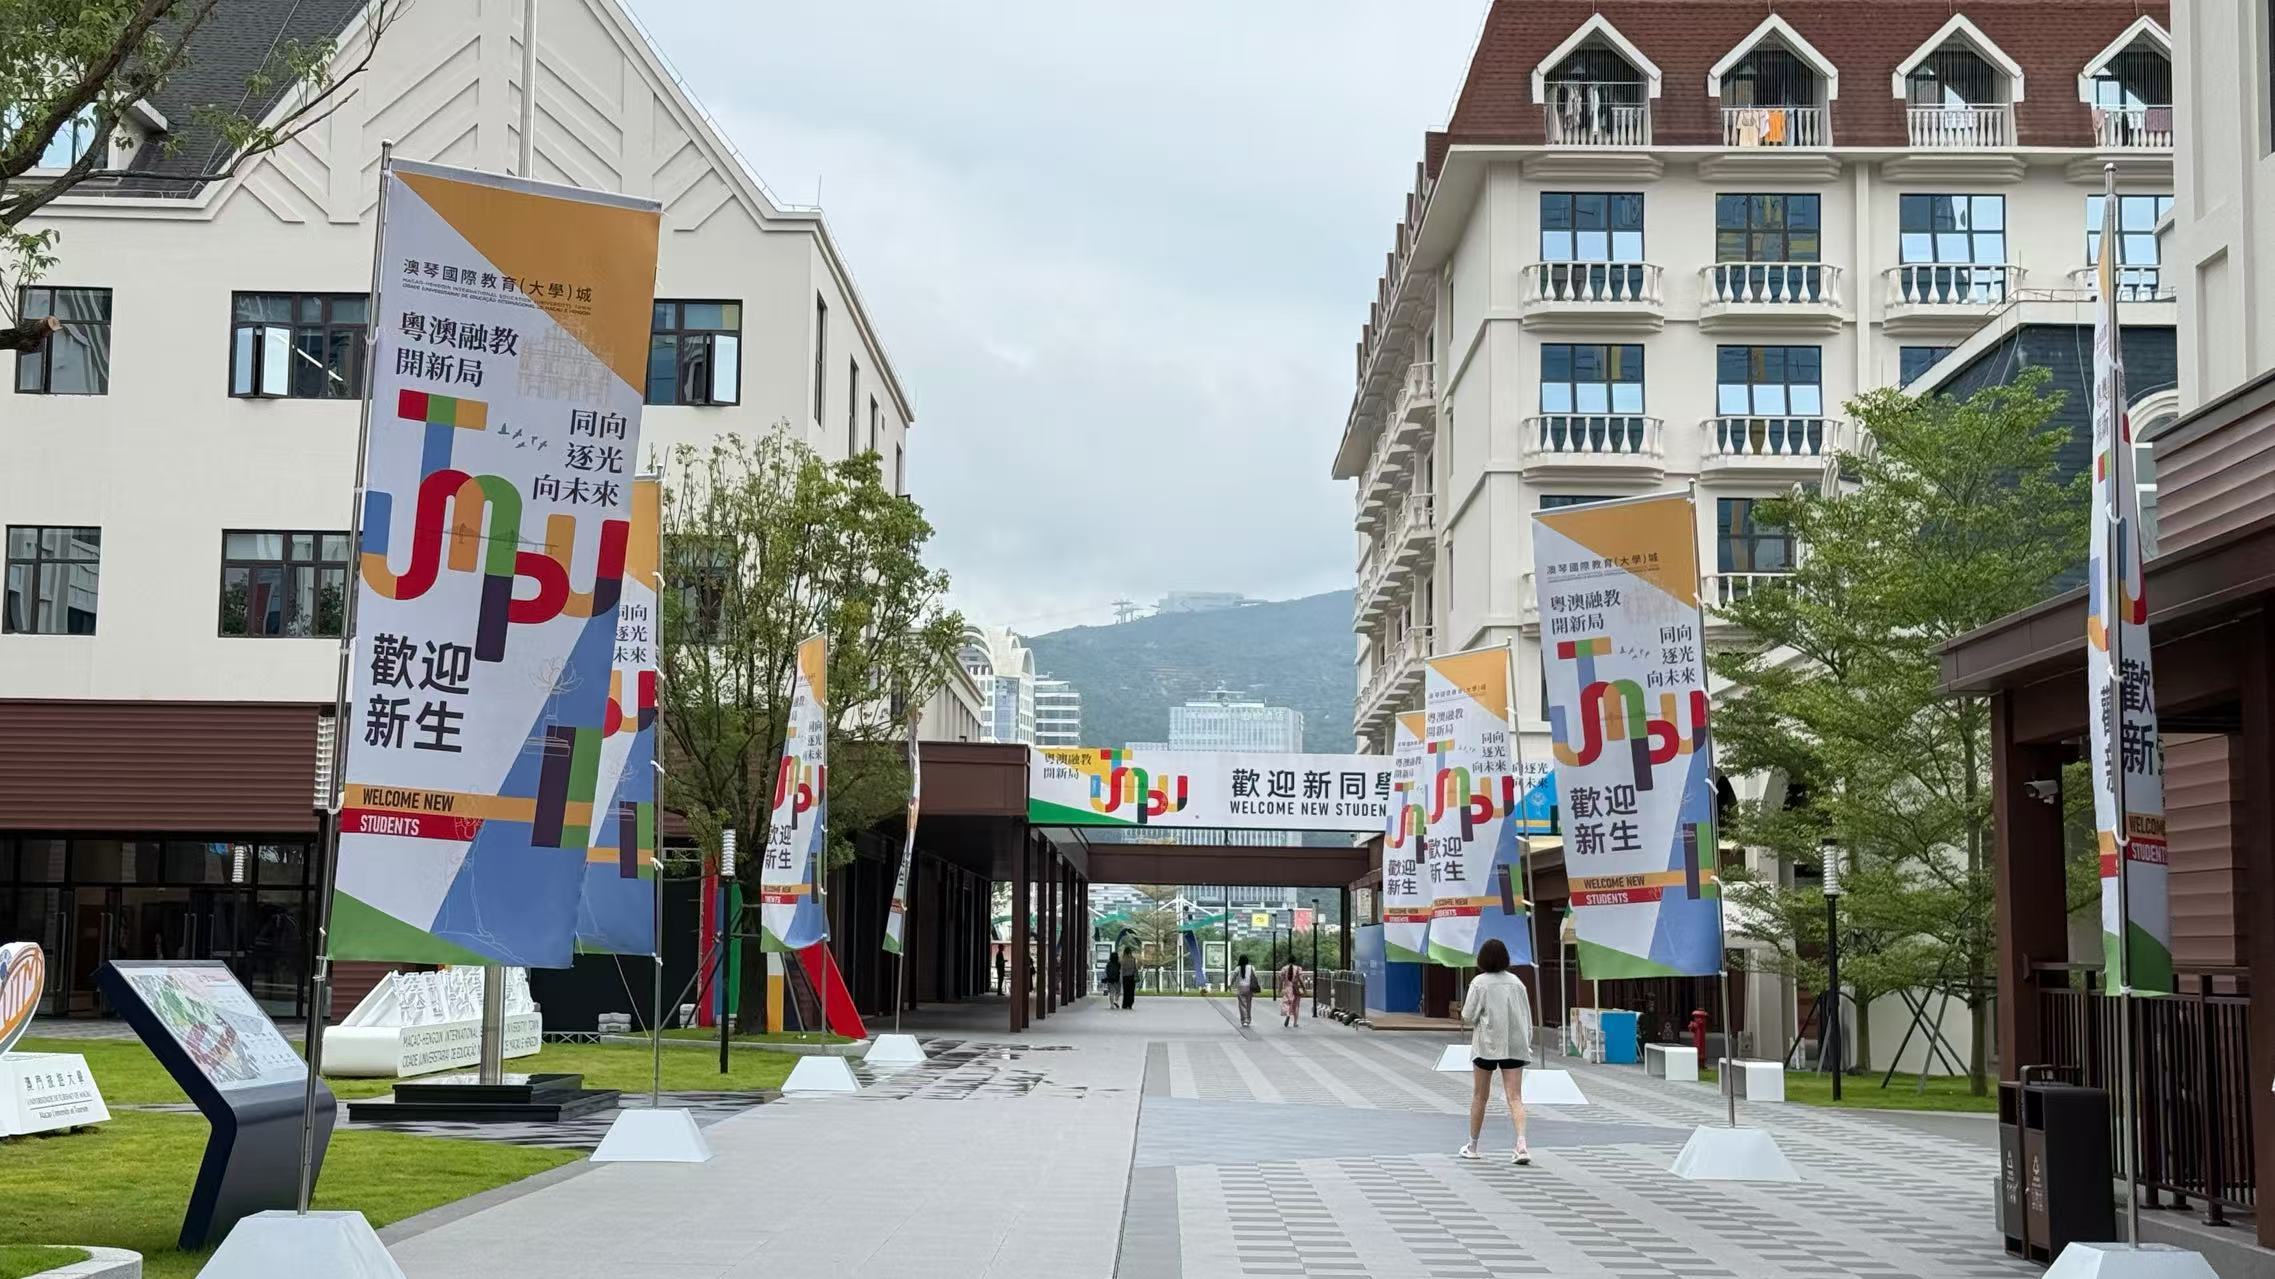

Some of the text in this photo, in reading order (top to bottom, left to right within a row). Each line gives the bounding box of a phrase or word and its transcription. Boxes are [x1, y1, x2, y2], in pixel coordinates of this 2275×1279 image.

[403, 258, 592, 302] 澳琴國際教育(大學)城
[395, 348, 484, 387] 開新局
[569, 409, 627, 440] 同向
[565, 443, 623, 473] 逐光
[532, 475, 619, 507] 向未來
[1551, 615, 1604, 635] 開新局
[1659, 624, 1693, 645] 同向
[370, 633, 472, 695] 歡迎
[1661, 645, 1695, 666] 逐光
[1646, 667, 1696, 688] 向未來
[364, 694, 464, 753] 新生
[1481, 731, 1505, 745] 同向
[363, 787, 455, 812] WELCOME NEW
[1229, 801, 1295, 816] WELCOME
[1301, 801, 1329, 816] NEW
[1570, 783, 1638, 820] 歡迎
[359, 814, 420, 836] STUDENTS
[1574, 819, 1642, 855] 新生
[1388, 859, 1417, 878] 歡迎
[1387, 878, 1418, 896] 新生
[1583, 874, 1646, 890] WELCOME NEW
[1586, 892, 1629, 906] STUDENTS
